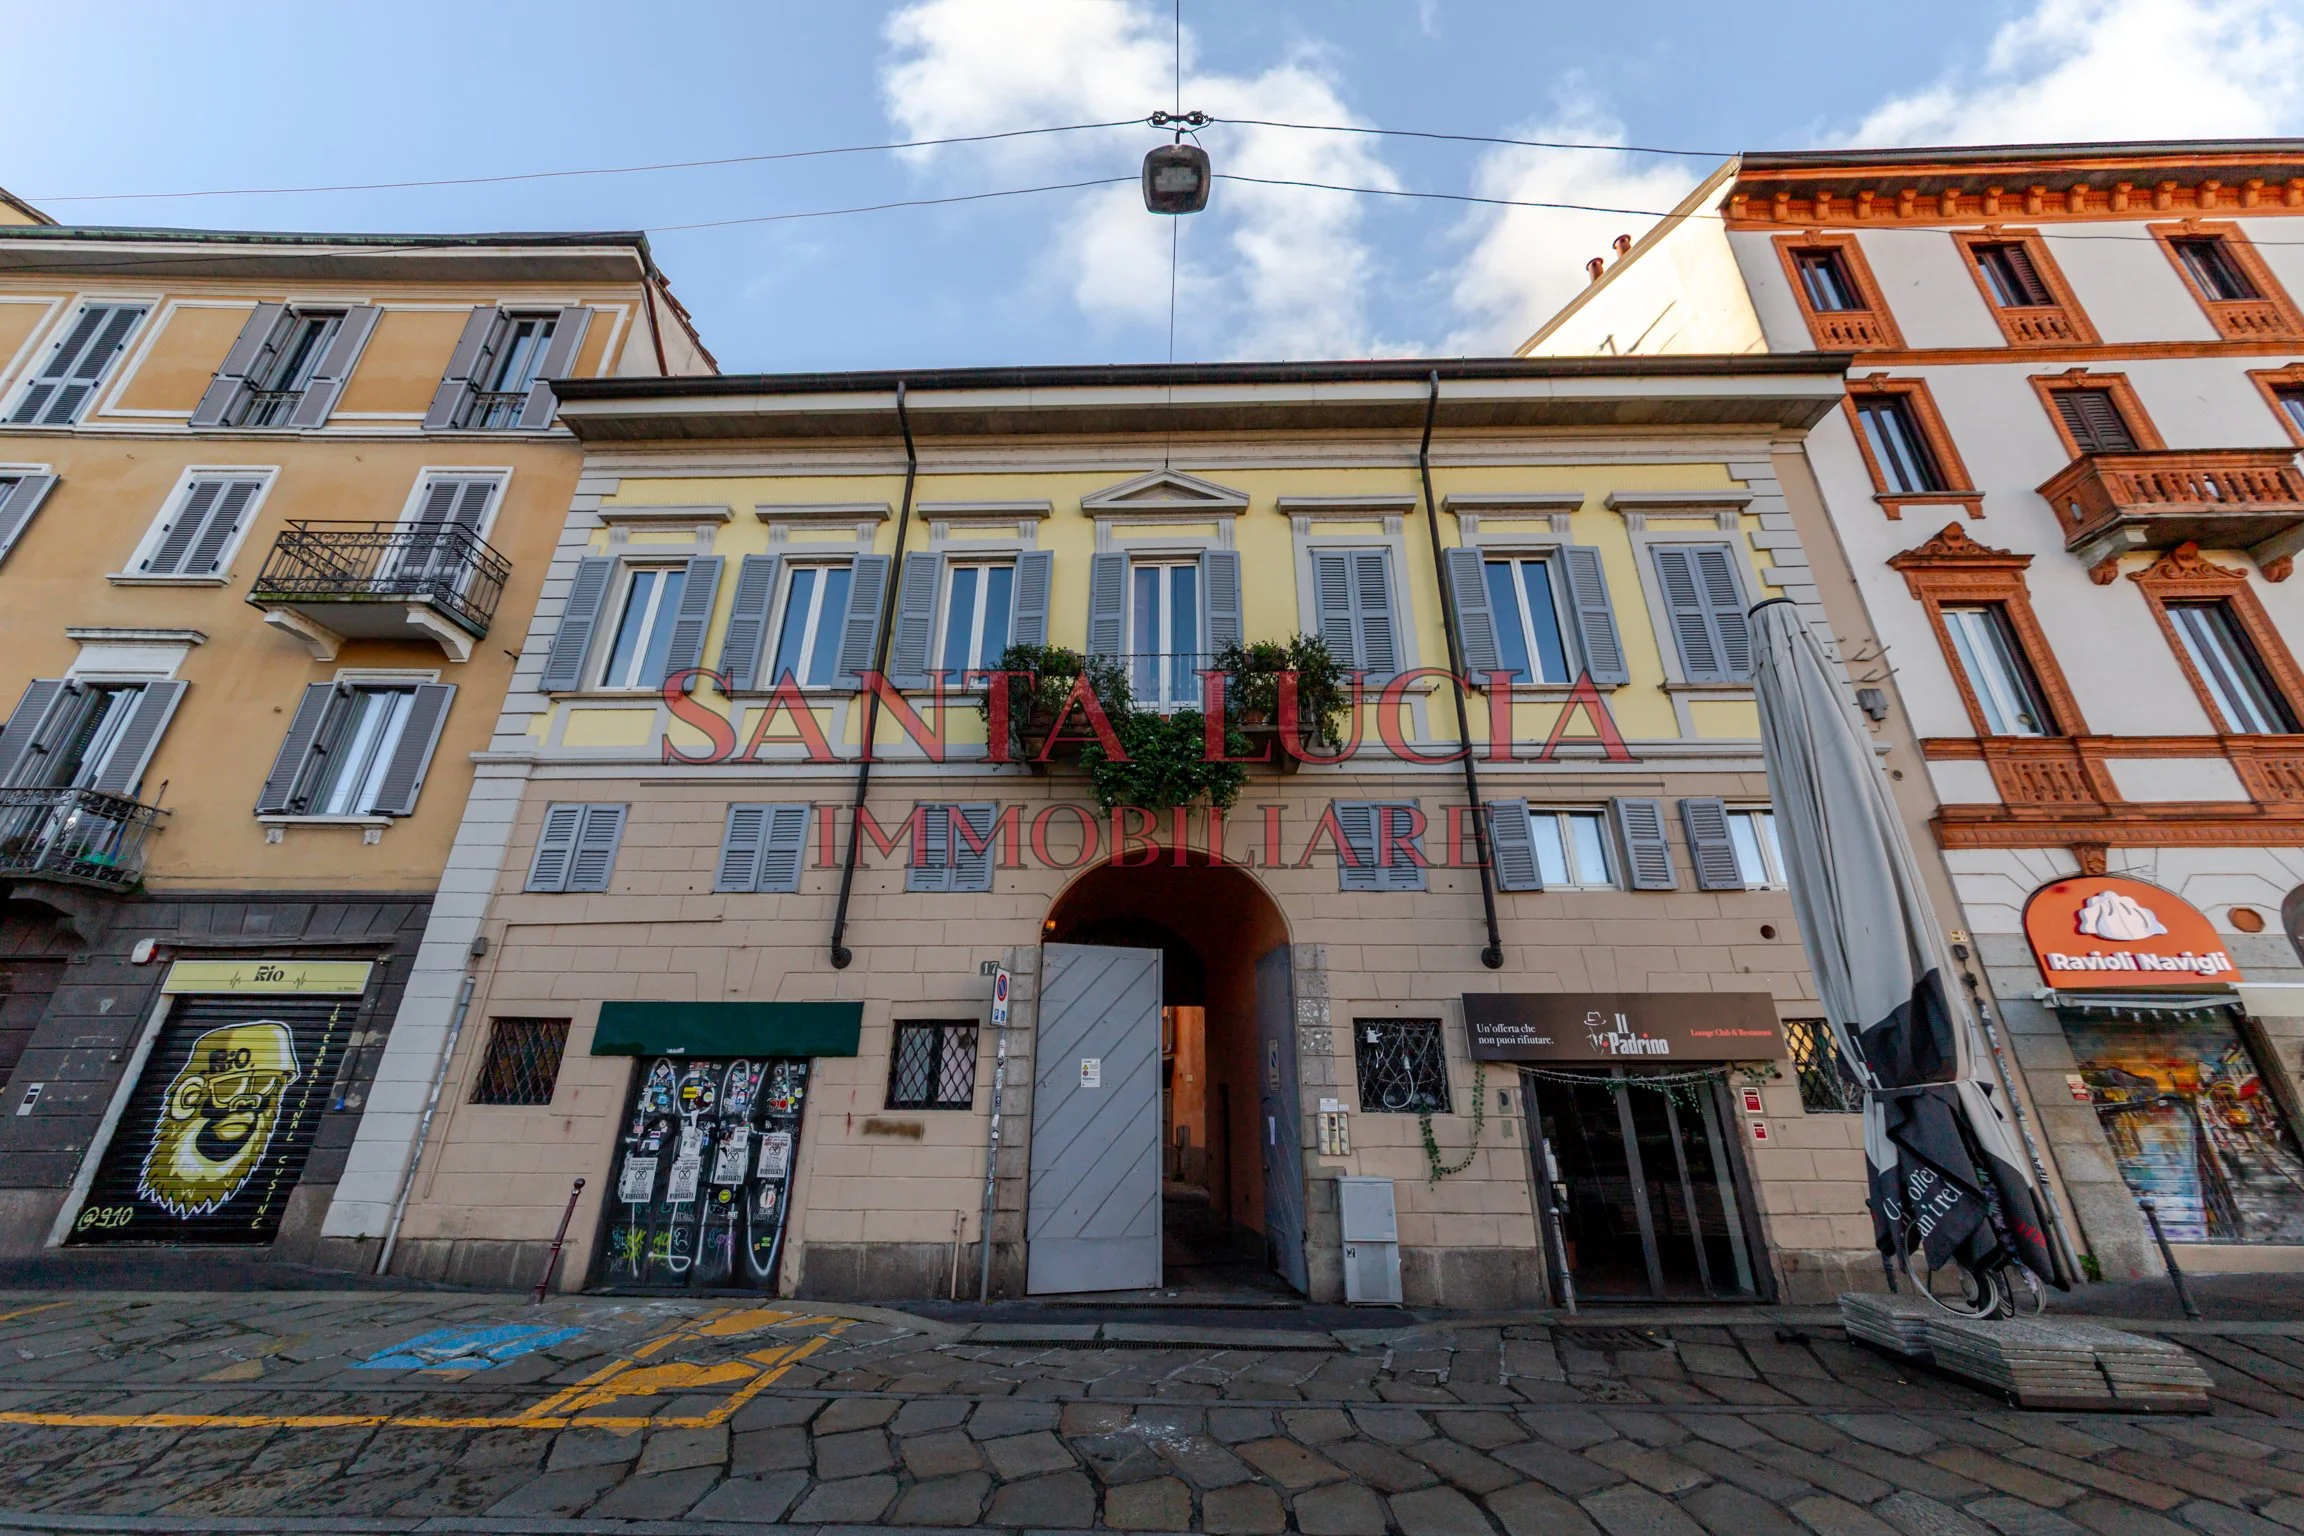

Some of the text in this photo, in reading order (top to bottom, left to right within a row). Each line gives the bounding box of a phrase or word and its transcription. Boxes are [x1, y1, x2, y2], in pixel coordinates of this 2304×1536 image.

[983, 962, 998, 975] 17
[2047, 950, 2233, 976] Ravioli Navigli
[254, 964, 285, 982] Rio
[1476, 1023, 1536, 1033] Un'offerta che
[1614, 1013, 1630, 1034] Il
[1715, 1028, 1731, 1037] Club
[1478, 1034, 1555, 1047] non puoi rifiutare.
[1607, 1032, 1670, 1055] Padrino
